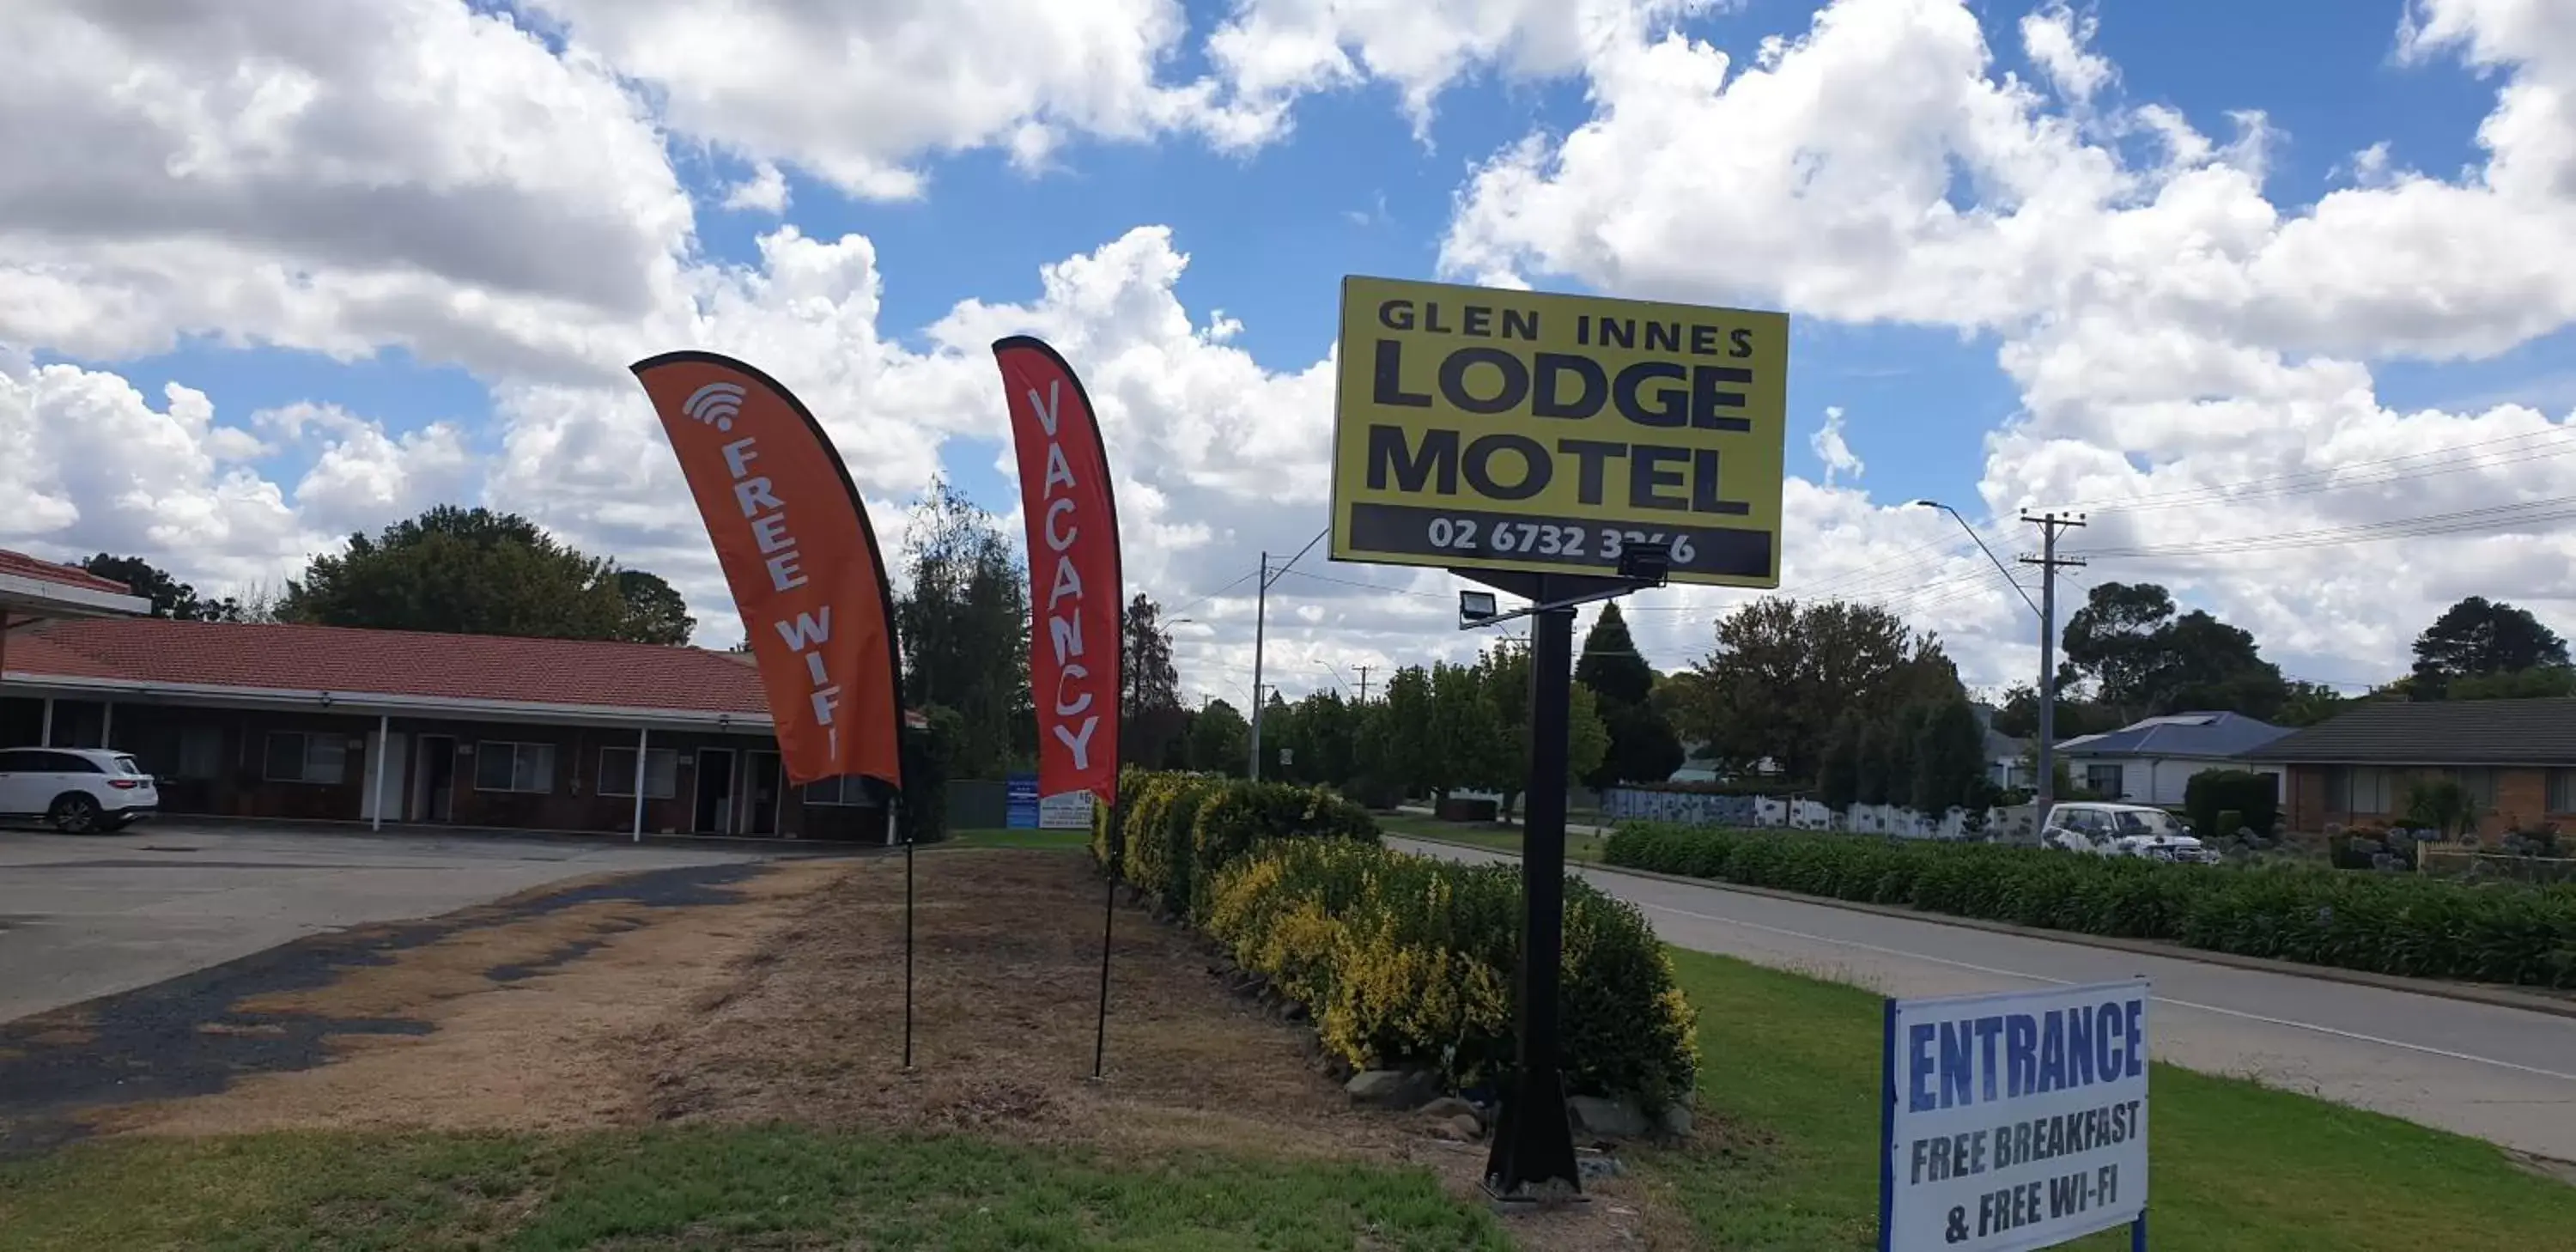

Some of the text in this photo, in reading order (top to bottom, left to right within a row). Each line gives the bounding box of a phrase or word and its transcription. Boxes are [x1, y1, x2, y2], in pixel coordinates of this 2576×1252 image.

[1378, 300, 1753, 358] GLEN INNES
[1373, 339, 1753, 432] LODGE
[1366, 424, 1750, 515] MOTEL
[1029, 380, 1100, 770] VACANCY
[1428, 517, 1477, 550] 02
[1491, 521, 1585, 556] 6732
[721, 436, 841, 761] FREE WIFI
[1909, 1000, 2142, 1113] ENTRANCE
[1911, 1100, 2141, 1185] FREE BREAKFAST
[1945, 1164, 2118, 1244] & FREE WI-FI
